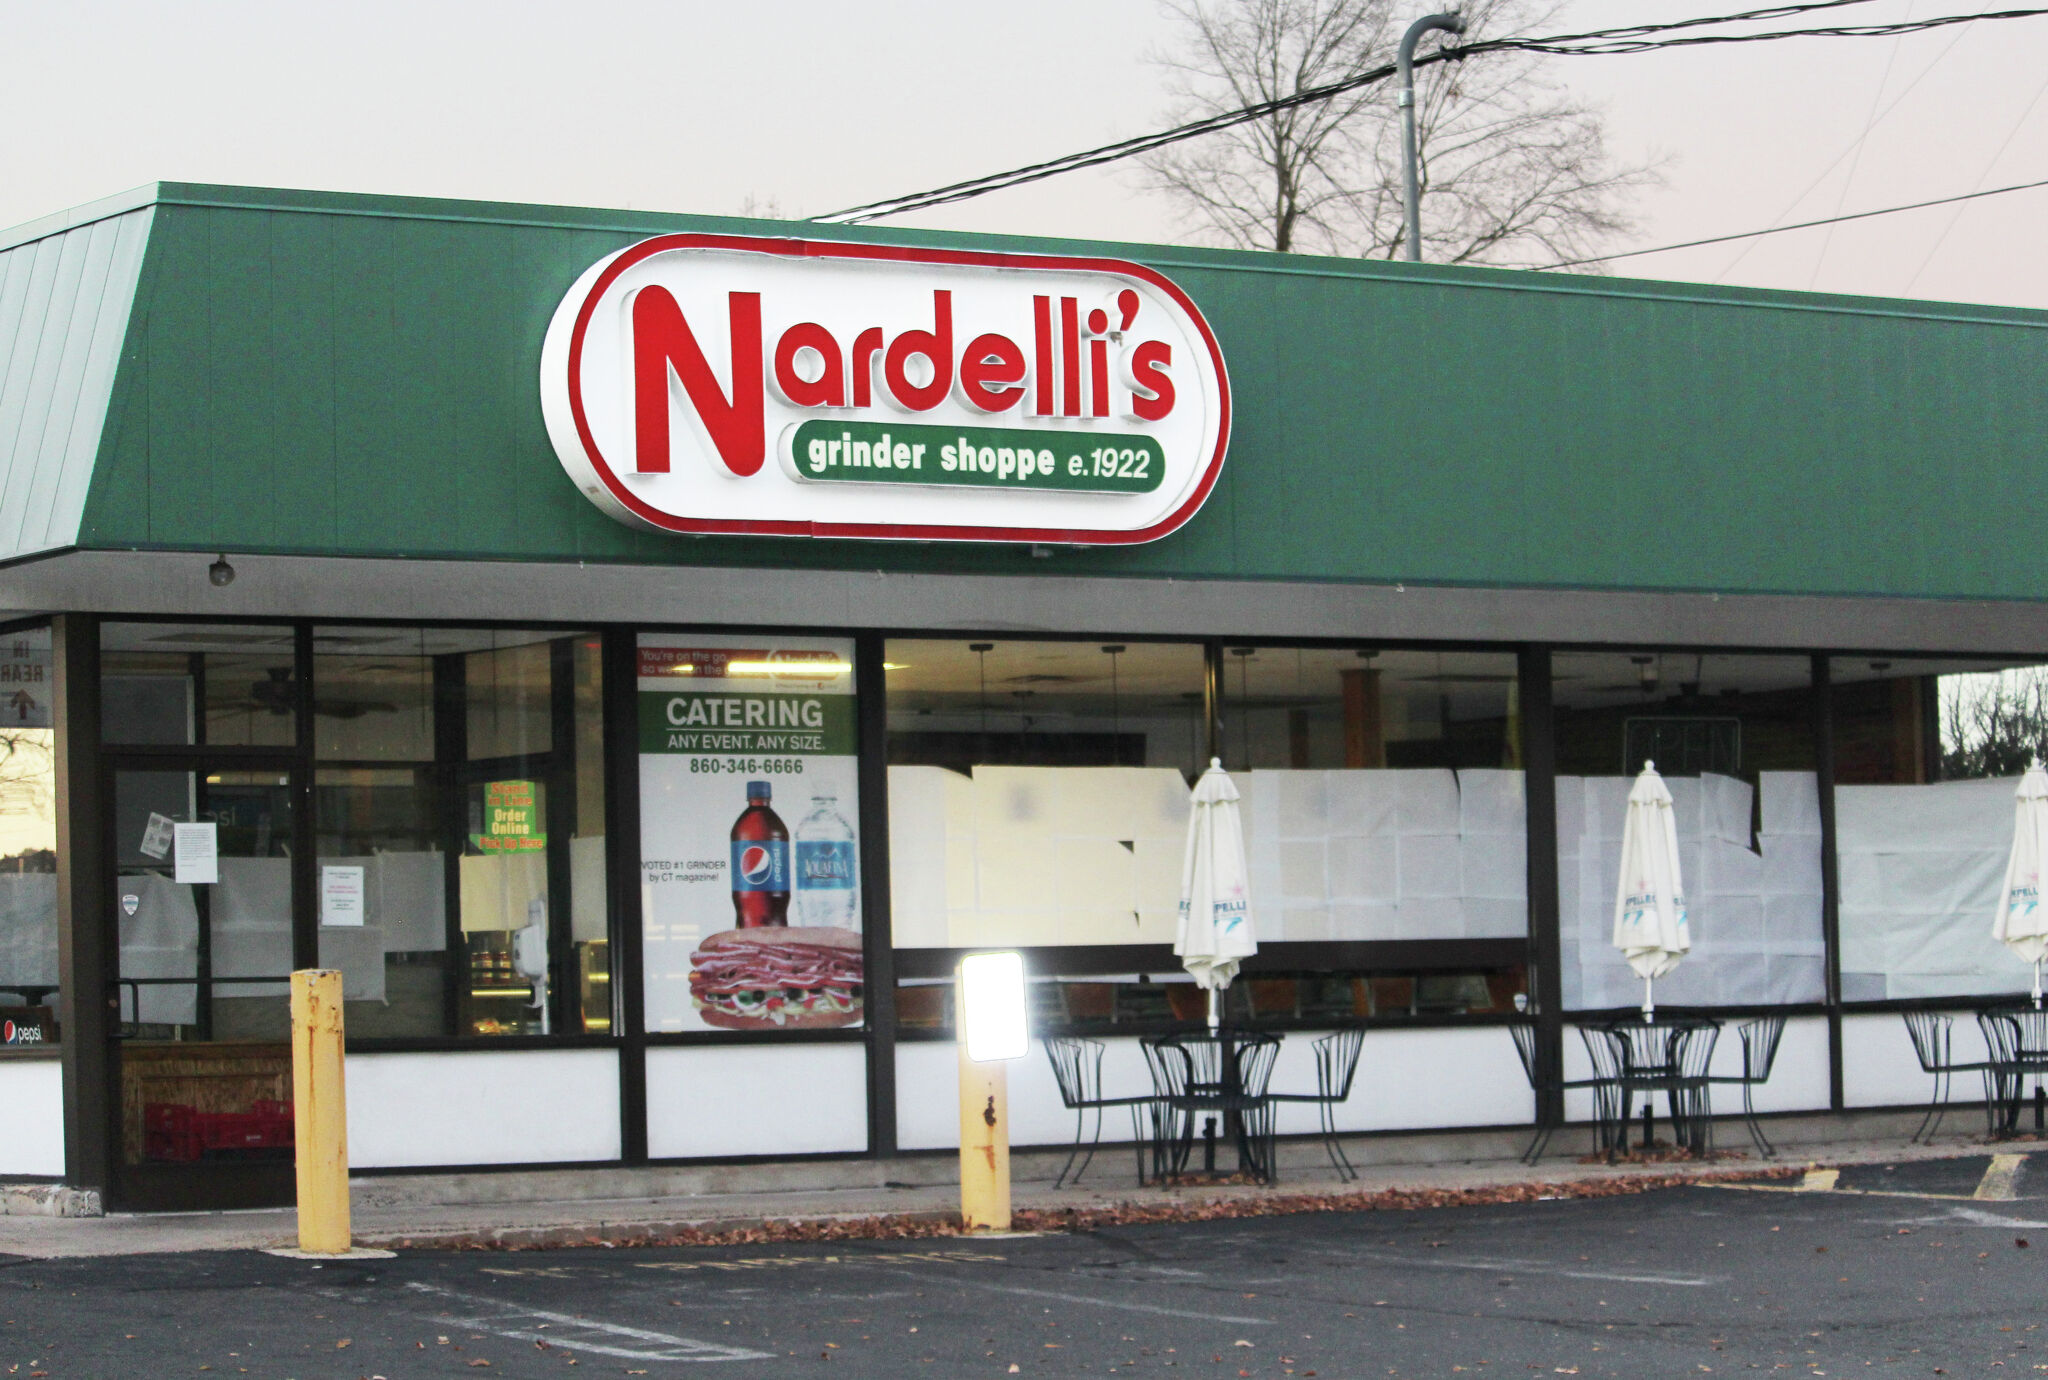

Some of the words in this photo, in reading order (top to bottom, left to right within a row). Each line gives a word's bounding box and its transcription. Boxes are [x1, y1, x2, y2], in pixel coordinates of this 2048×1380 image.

[632, 284, 1176, 478] Nardelli's
[808, 432, 926, 472] grinder
[940, 437, 1056, 480] shoppe
[1067, 448, 1151, 479] e.1922
[641, 649, 674, 662] You're
[676, 652, 691, 662] on
[692, 650, 711, 662] the
[666, 697, 824, 727] CATERING
[668, 734, 699, 749] ANY
[702, 734, 753, 750] EVENT.
[756, 735, 786, 750] ANY
[790, 735, 826, 750] SIZE.
[690, 758, 803, 774] 860-346-6666
[491, 782, 529, 794] Stand
[488, 794, 500, 806] in
[504, 795, 533, 806] Line
[494, 809, 526, 822] Order
[491, 822, 530, 835] Online
[480, 837, 501, 849] Pick
[504, 837, 517, 851] Up
[519, 837, 543, 849] Here
[641, 861, 672, 870] VOTED
[673, 861, 684, 870] #1
[686, 861, 727, 870] GRINDER
[773, 848, 783, 883] pepsi
[649, 873, 659, 883] by
[661, 873, 673, 882] CT
[17, 1024, 42, 1045] pepsi
